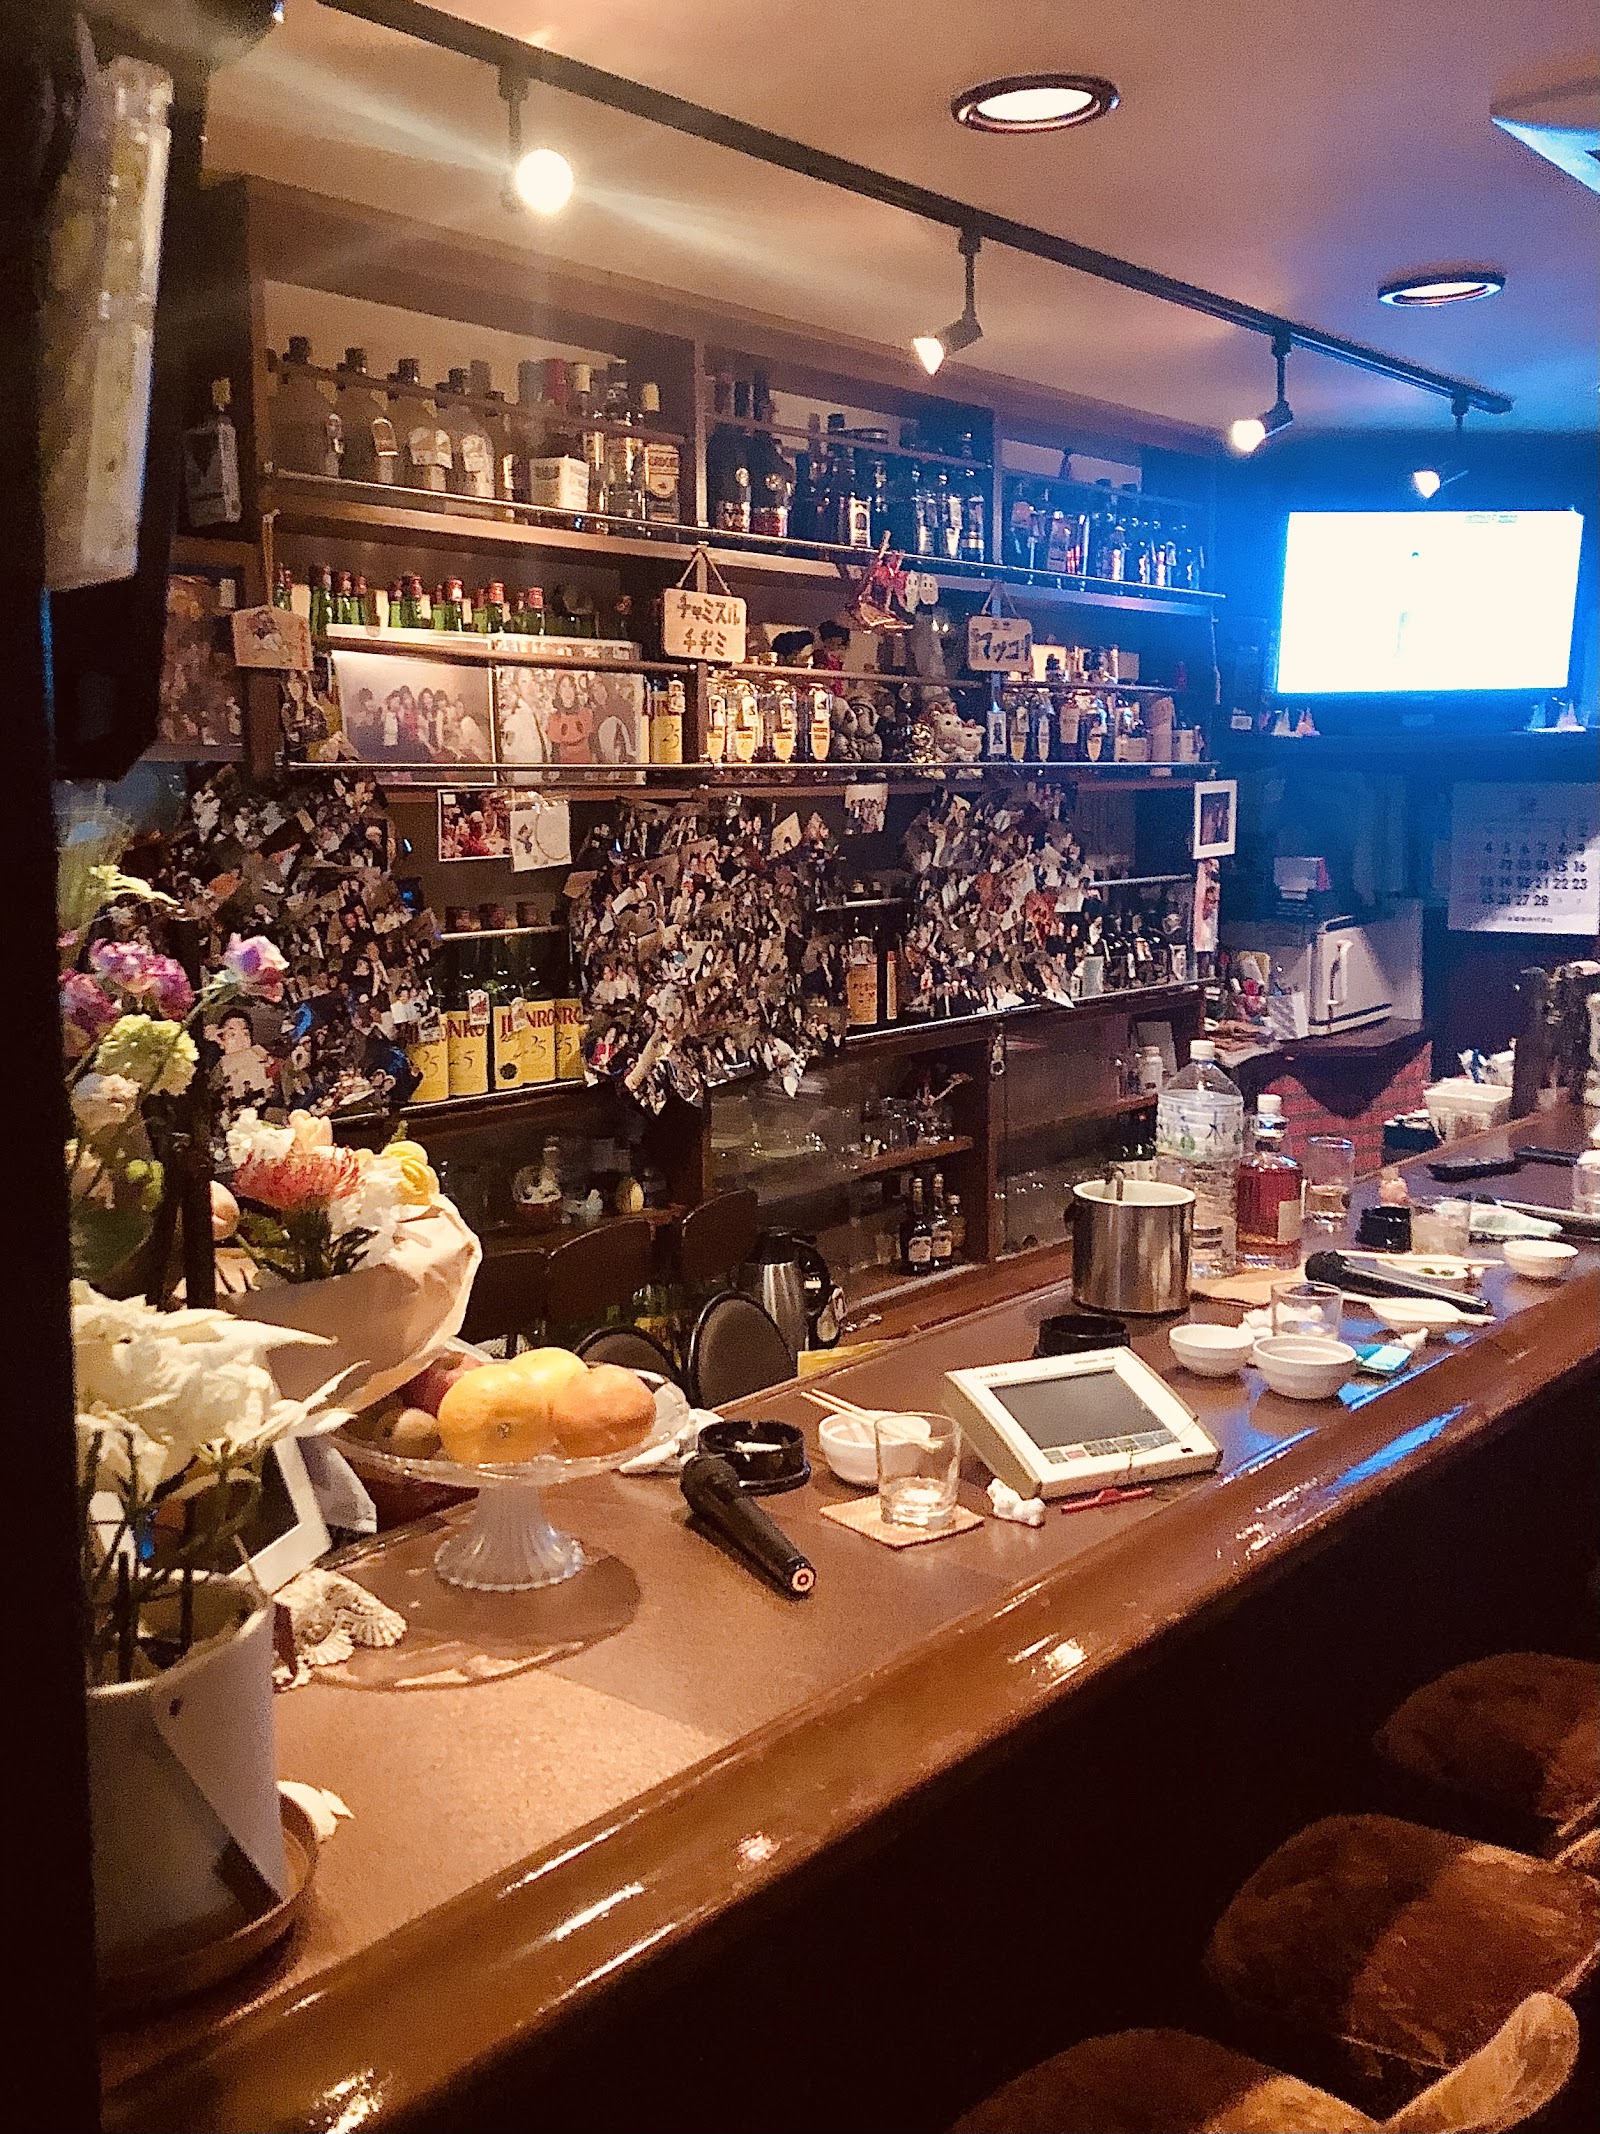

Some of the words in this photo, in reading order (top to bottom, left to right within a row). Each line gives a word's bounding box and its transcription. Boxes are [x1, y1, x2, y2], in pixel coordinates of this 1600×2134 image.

[677, 593, 741, 625] チャミスル
[1573, 860, 1586, 872] 16
[1535, 878, 1548, 889] 21
[1553, 878, 1568, 889] 22
[1572, 878, 1587, 890] 23
[1515, 895, 1529, 906] 27
[1534, 895, 1549, 906] 28
